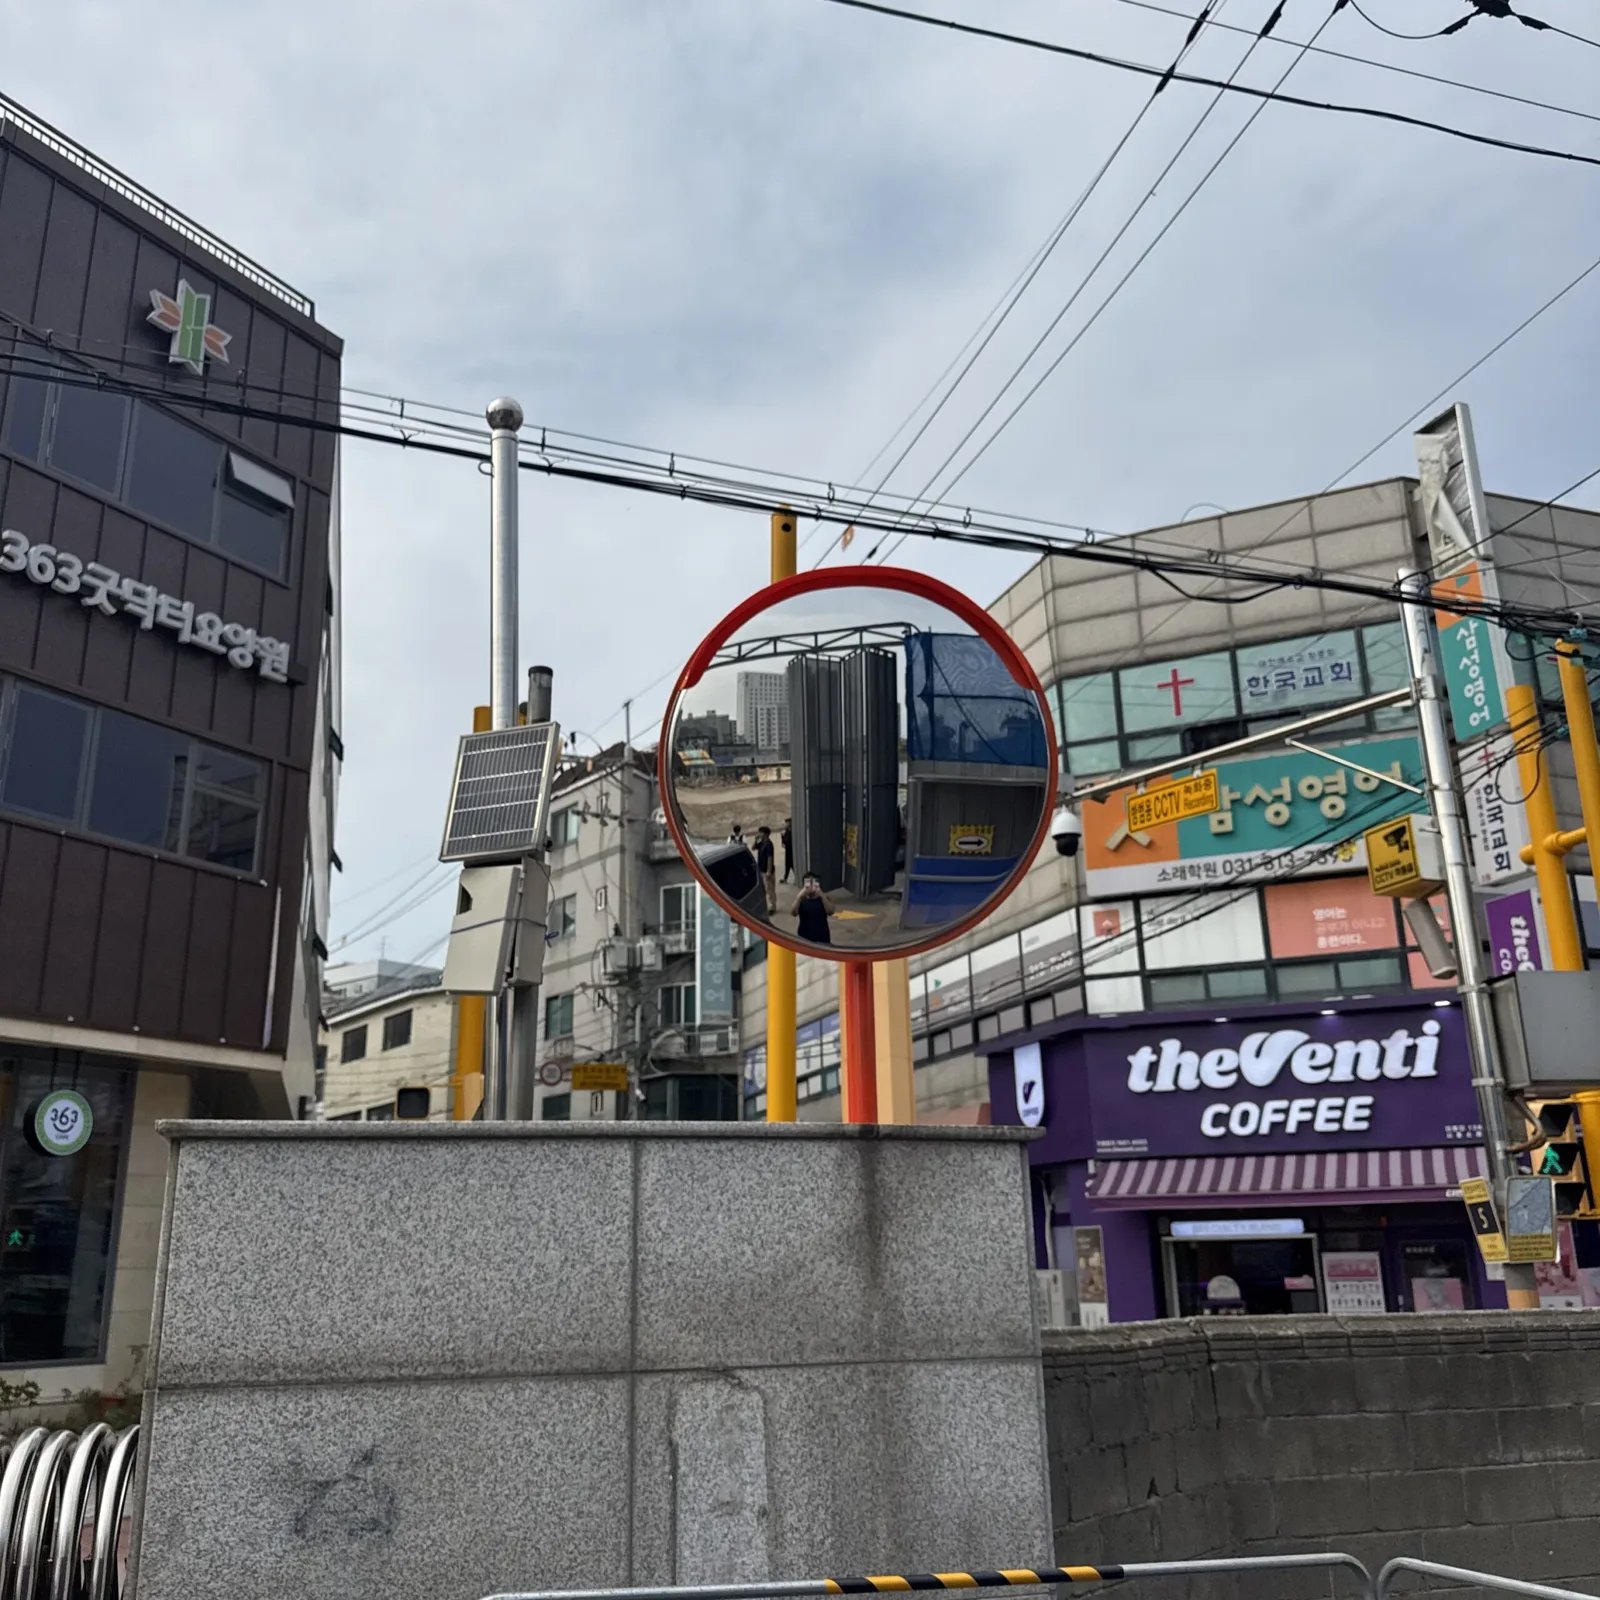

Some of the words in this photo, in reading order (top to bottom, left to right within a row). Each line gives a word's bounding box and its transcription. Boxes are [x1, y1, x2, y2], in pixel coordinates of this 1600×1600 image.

[1246, 662, 1353, 697] 한국교회
[1456, 619, 1491, 727] 삼성영어
[1153, 789, 1180, 820] CCTV
[1483, 783, 1513, 872] 한국교회
[1156, 862, 1219, 883] 소래학원
[50, 1106, 79, 1126] 363
[1200, 1095, 1375, 1137] COFFEE
